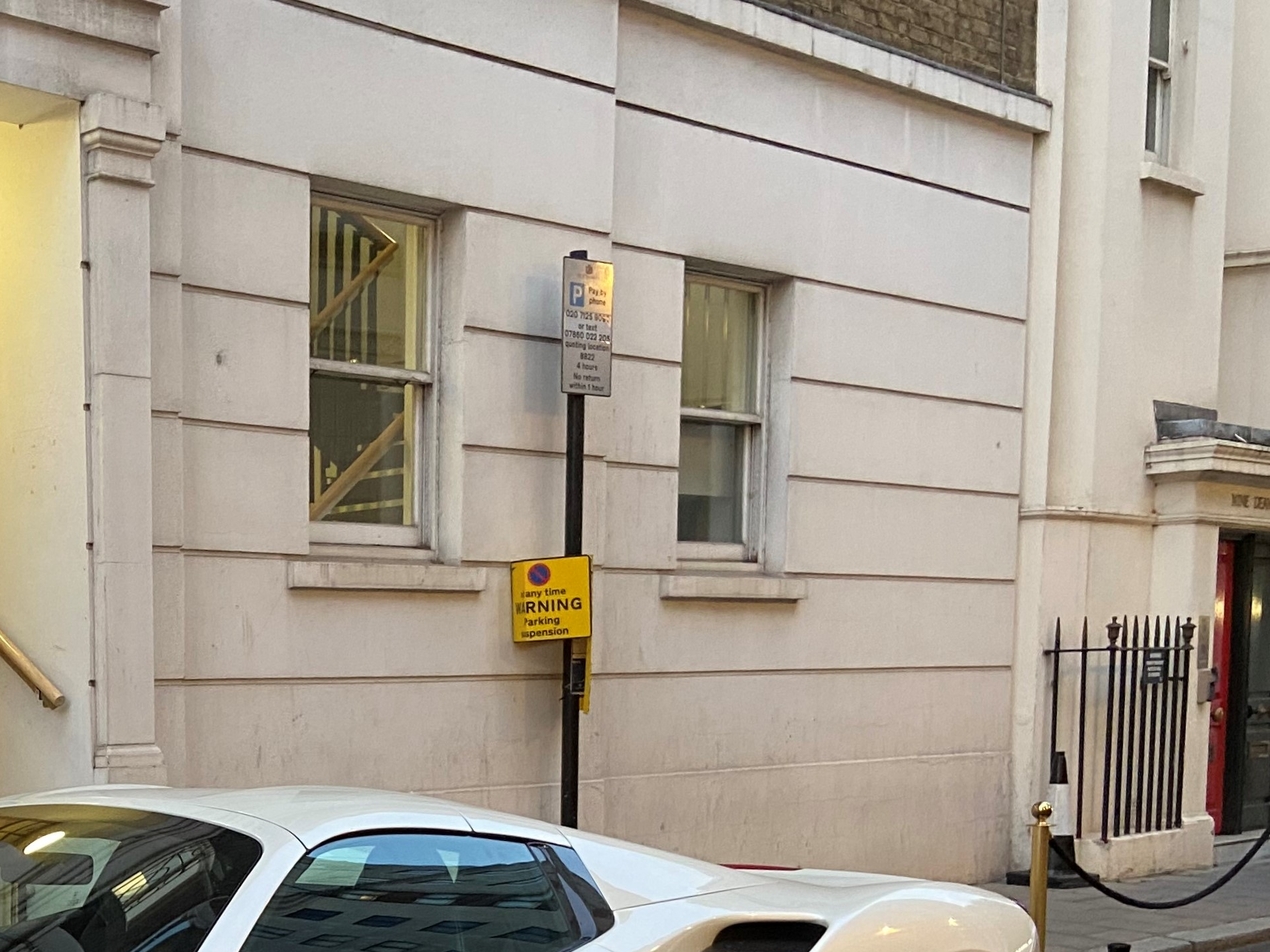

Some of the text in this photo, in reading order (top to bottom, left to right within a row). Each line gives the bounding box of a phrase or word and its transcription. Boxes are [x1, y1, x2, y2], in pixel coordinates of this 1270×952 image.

[573, 285, 582, 304] P
[588, 287, 607, 298] Pay by
[588, 297, 606, 307] phone
[586, 324, 598, 332] text
[565, 341, 610, 352] quoting location
[582, 362, 598, 371] hours
[573, 372, 601, 382] No return
[569, 381, 587, 390] within
[591, 384, 605, 392] hour
[545, 588, 566, 597] time
